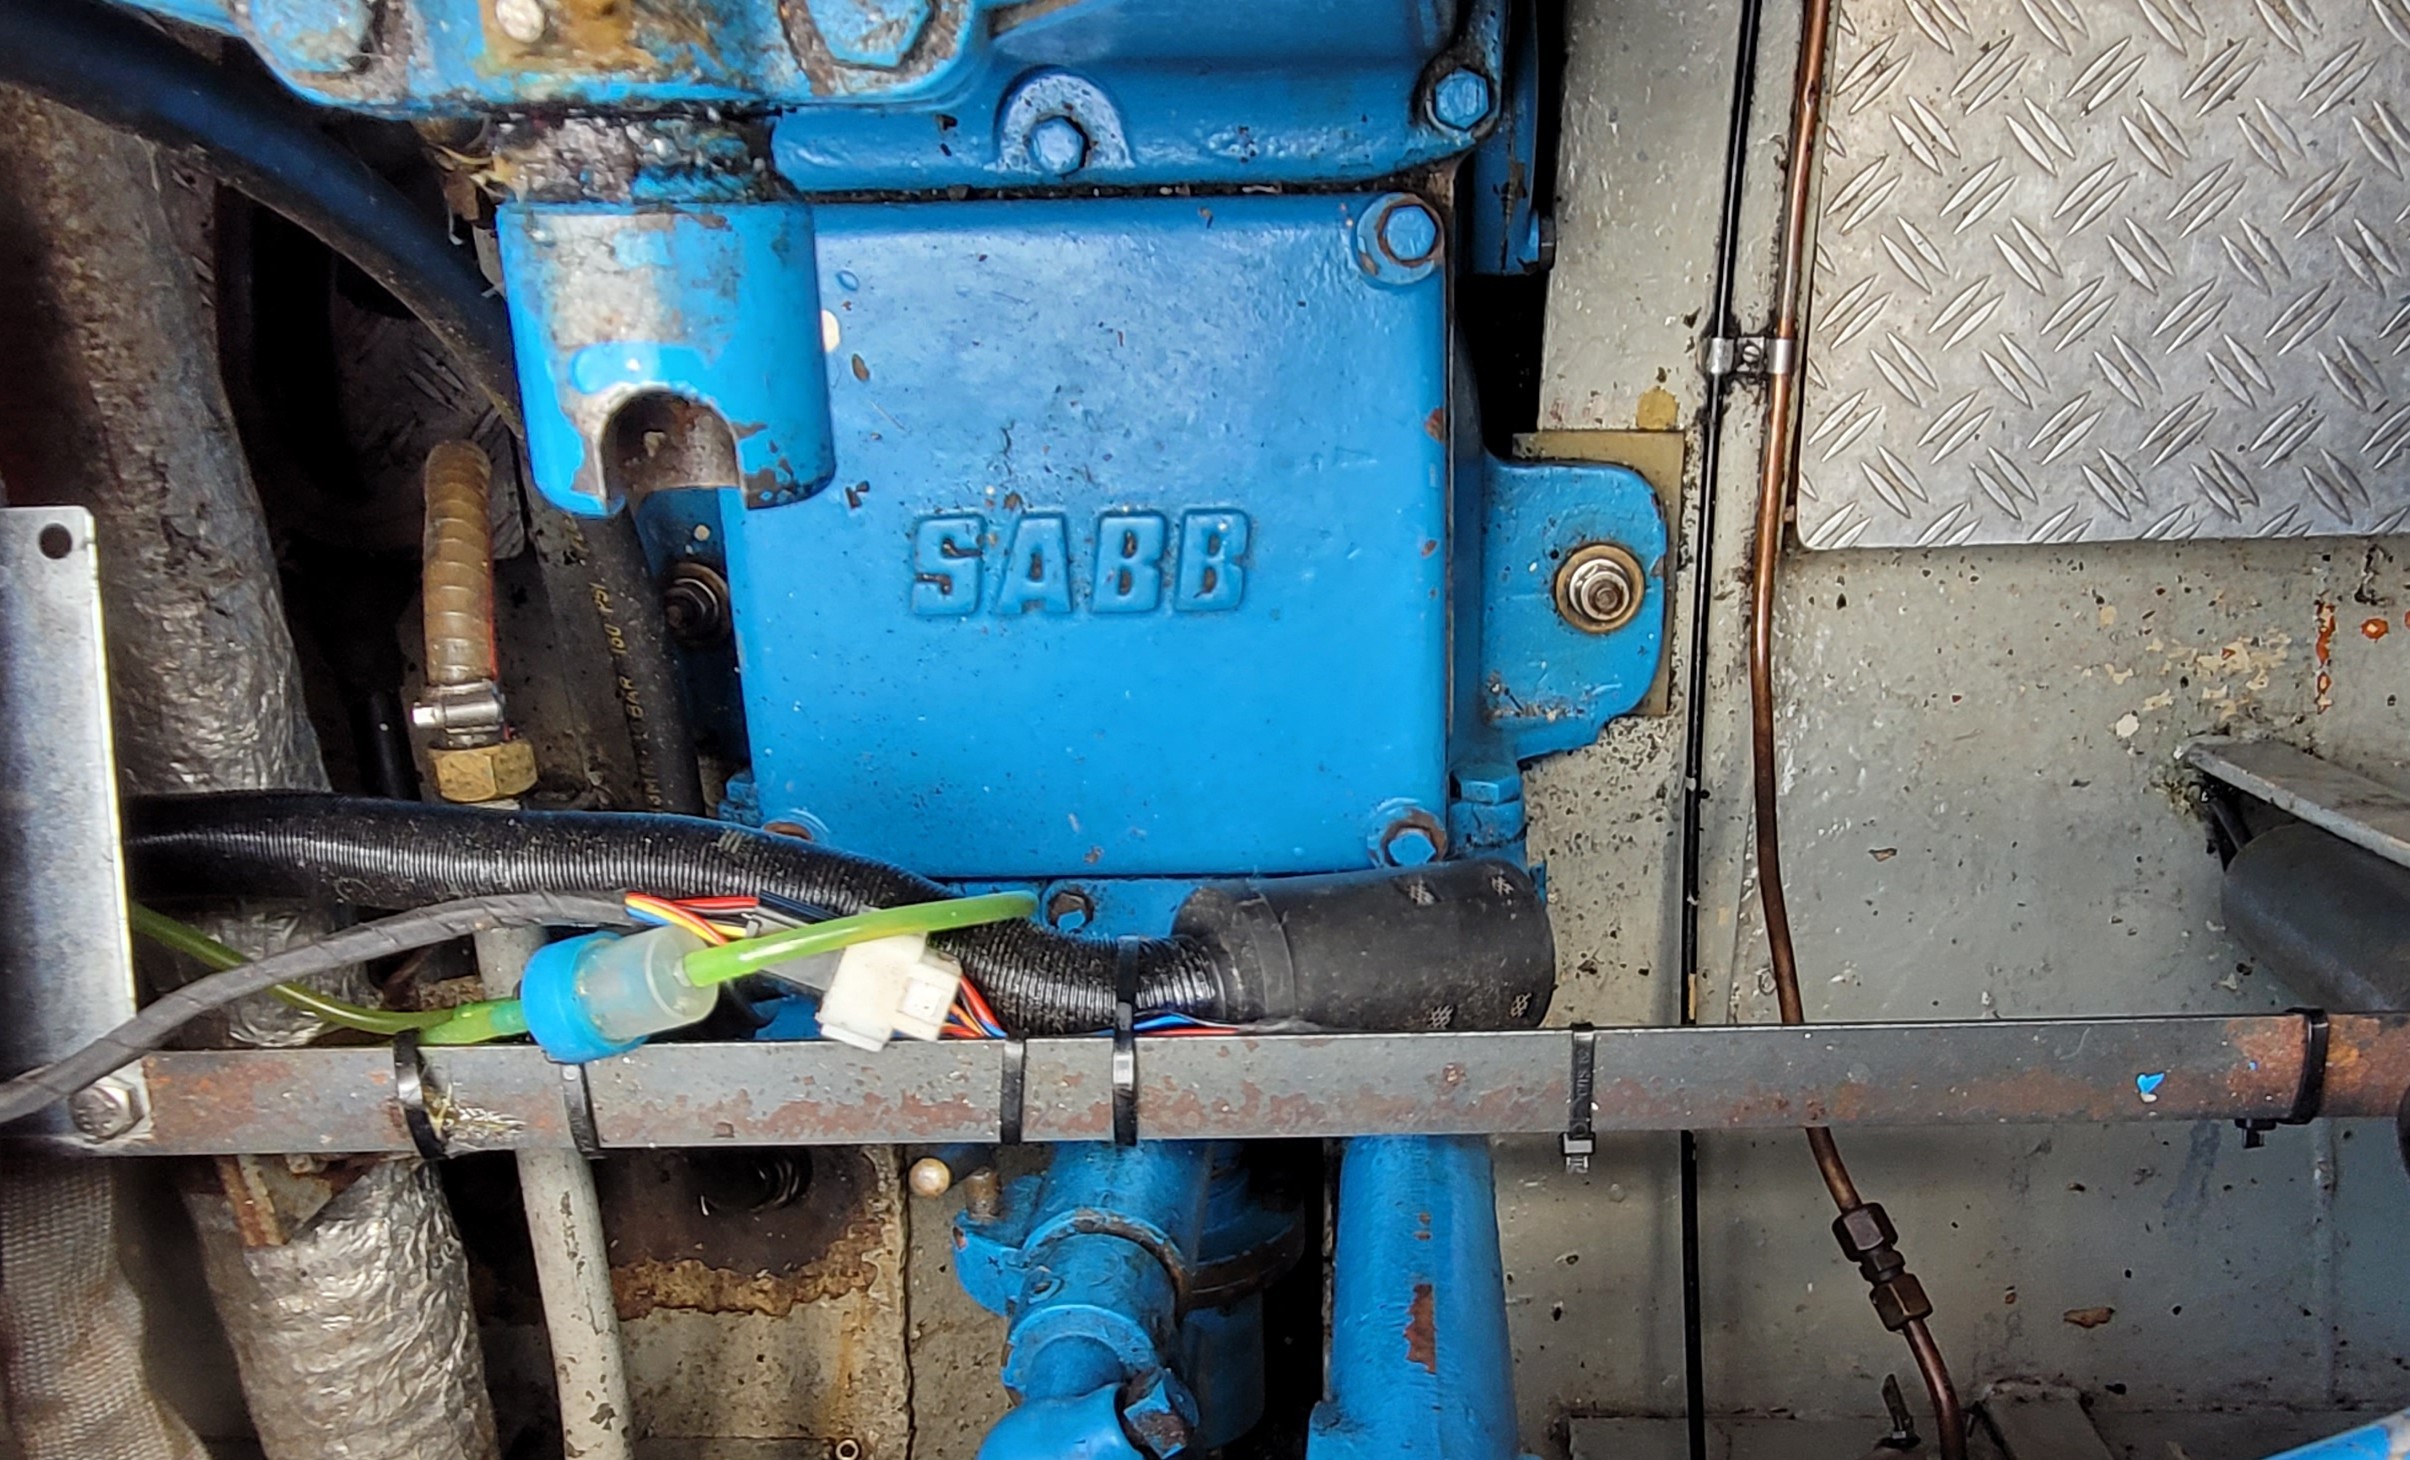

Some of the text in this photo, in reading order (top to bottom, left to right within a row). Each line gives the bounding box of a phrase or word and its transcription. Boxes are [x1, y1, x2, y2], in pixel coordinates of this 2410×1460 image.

[911, 508, 1250, 616] SABB
[588, 582, 614, 614] PSI
[619, 675, 644, 719] BAR
